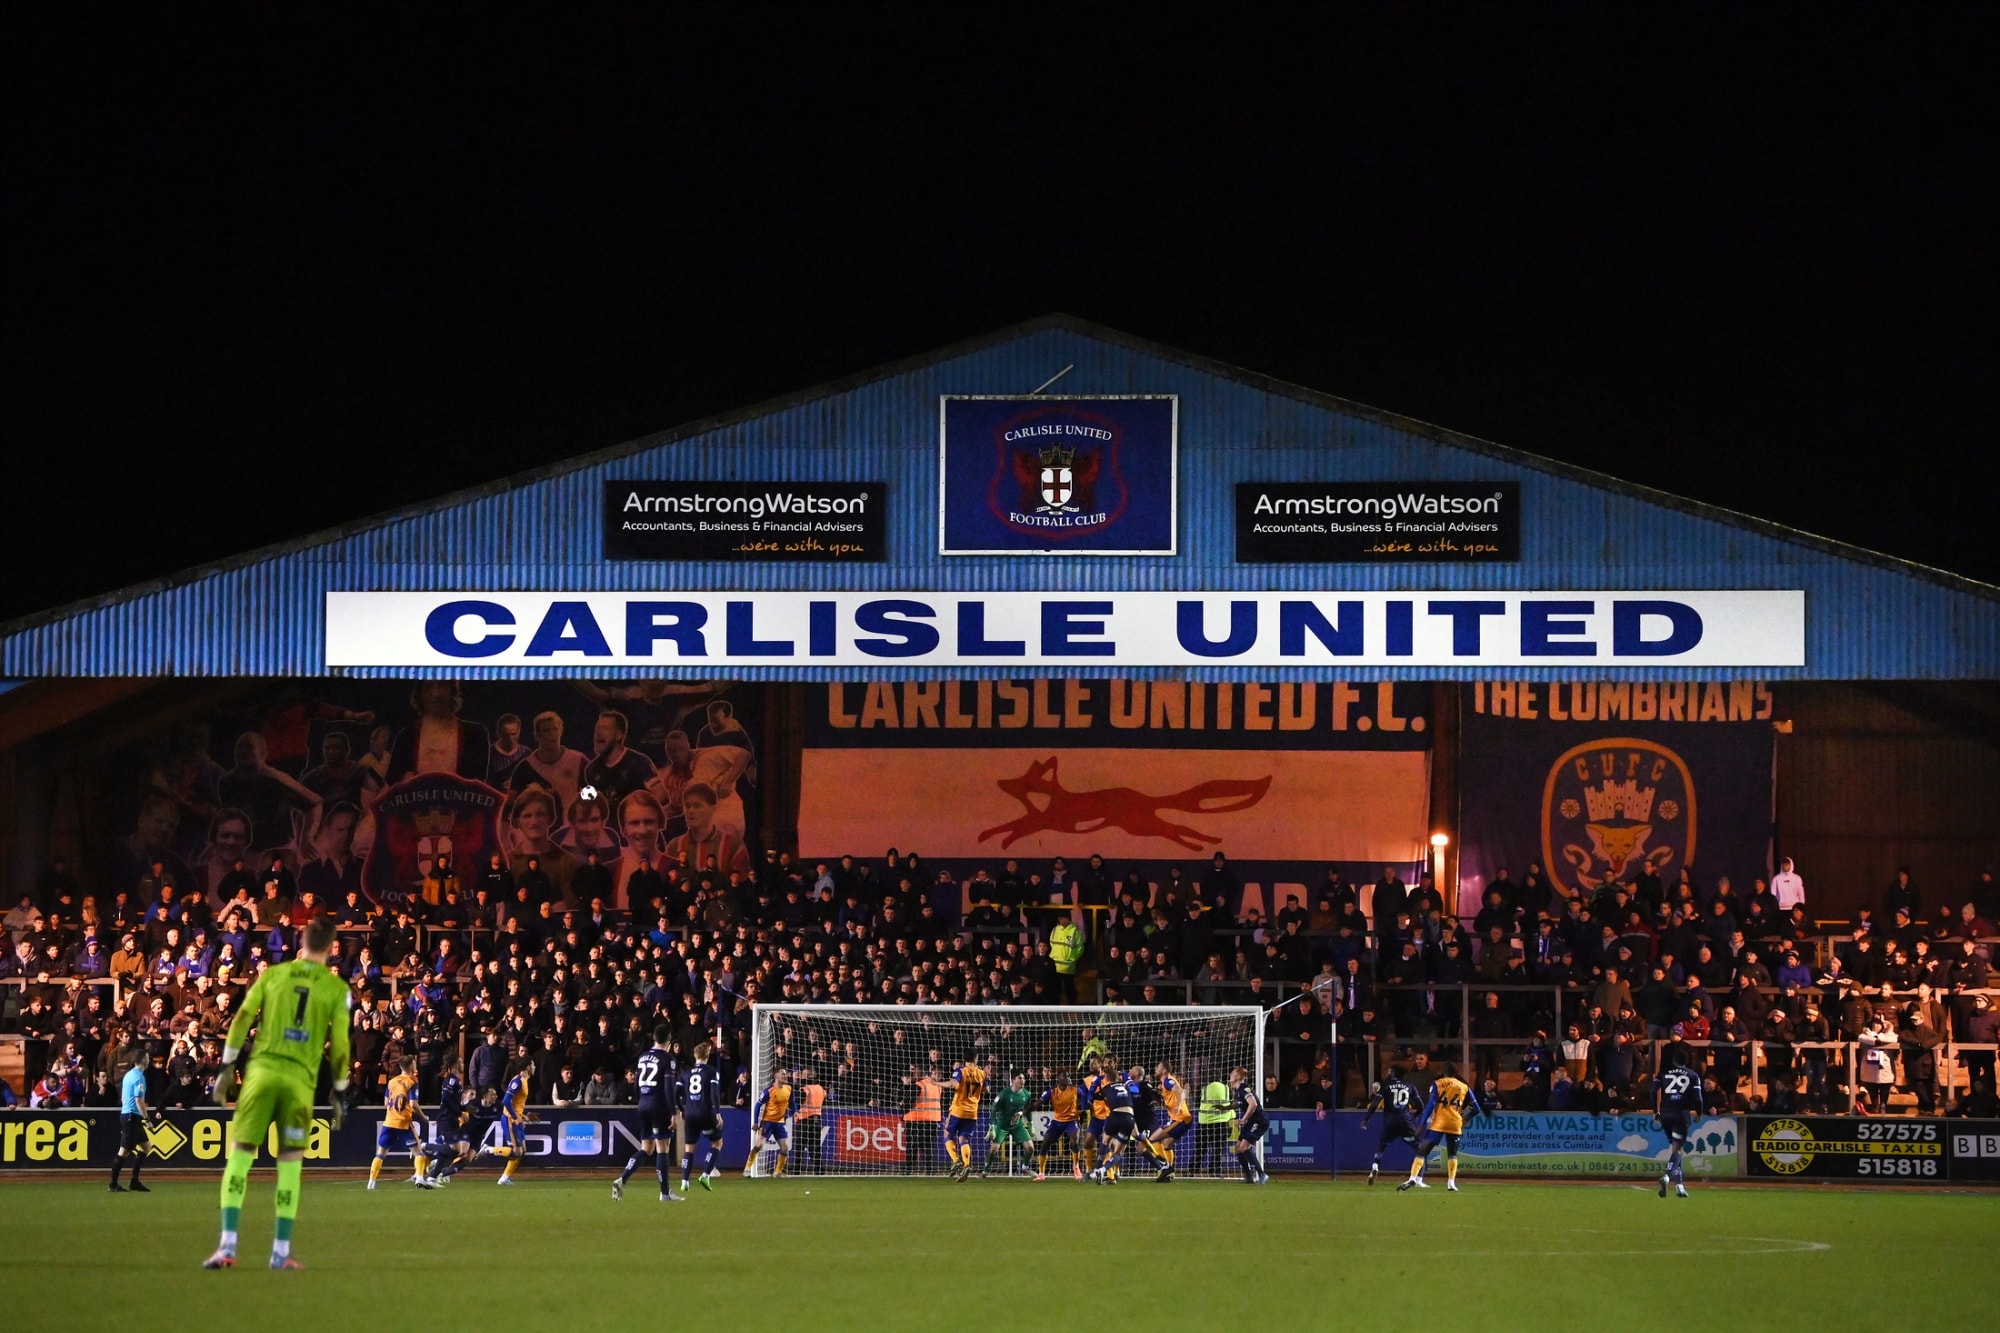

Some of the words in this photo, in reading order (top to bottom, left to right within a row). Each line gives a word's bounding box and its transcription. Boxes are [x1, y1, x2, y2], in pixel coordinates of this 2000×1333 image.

[1004, 424, 1063, 441] CARLISLE
[1065, 424, 1112, 441] UNITED
[622, 521, 696, 533] Accountants,
[699, 522, 749, 532] Business
[752, 522, 760, 532] &
[763, 522, 812, 532] Financial
[814, 522, 864, 532] Advisers
[1009, 512, 1073, 527] FOOTBALL
[1075, 512, 1106, 526] CLUB
[1253, 522, 1328, 534] Accountants,
[1330, 522, 1381, 533] Business
[1384, 522, 1392, 532] &
[1395, 522, 1445, 532] Financial
[1448, 522, 1498, 532] Advisers
[785, 536, 825, 552] with
[829, 543, 864, 557] you
[1418, 536, 1458, 552] with
[1463, 543, 1499, 557] you
[424, 599, 1116, 659] CARLISLE
[1175, 600, 1704, 658] UNITED
[828, 679, 1093, 729] CARLISLE
[1110, 679, 1316, 731] UNITED
[1474, 681, 1538, 720] THE
[1549, 681, 1773, 722] CUMBRIANS
[443, 789, 495, 807] UNITED
[293, 985, 310, 1027] 1
[637, 1062, 659, 1087] 22
[689, 1074, 702, 1094] 8
[1664, 1074, 1690, 1094] 29
[1391, 1089, 1410, 1106] 10
[1437, 1091, 1461, 1111] 44
[1464, 1116, 1538, 1131] UMBRIA
[1545, 1116, 1614, 1132] WASTE
[1621, 1117, 1664, 1132] GRO
[1764, 1120, 1810, 1137] 527575
[1857, 1123, 1937, 1141] 527575
[0, 1119, 89, 1162] rea
[846, 1120, 906, 1151] bet
[1467, 1132, 1499, 1142] largest
[1502, 1132, 1542, 1142] provider
[1545, 1132, 1555, 1140] of
[1557, 1133, 1585, 1141] waste
[1588, 1132, 1606, 1141] and
[1491, 1141, 1528, 1149] services
[1531, 1141, 1561, 1149] across
[1563, 1141, 1603, 1150] Cumbria
[1756, 1141, 1800, 1151] RADIO
[1804, 1142, 1871, 1153] CARLISLE
[1881, 1143, 1937, 1154] TAXIS
[1267, 1156, 1314, 1164] DISTRIBUTION
[1588, 1162, 1615, 1171] 0845
[1619, 1162, 1637, 1171] 241
[1765, 1156, 1810, 1173] 515818
[1857, 1158, 1937, 1176] 515818
